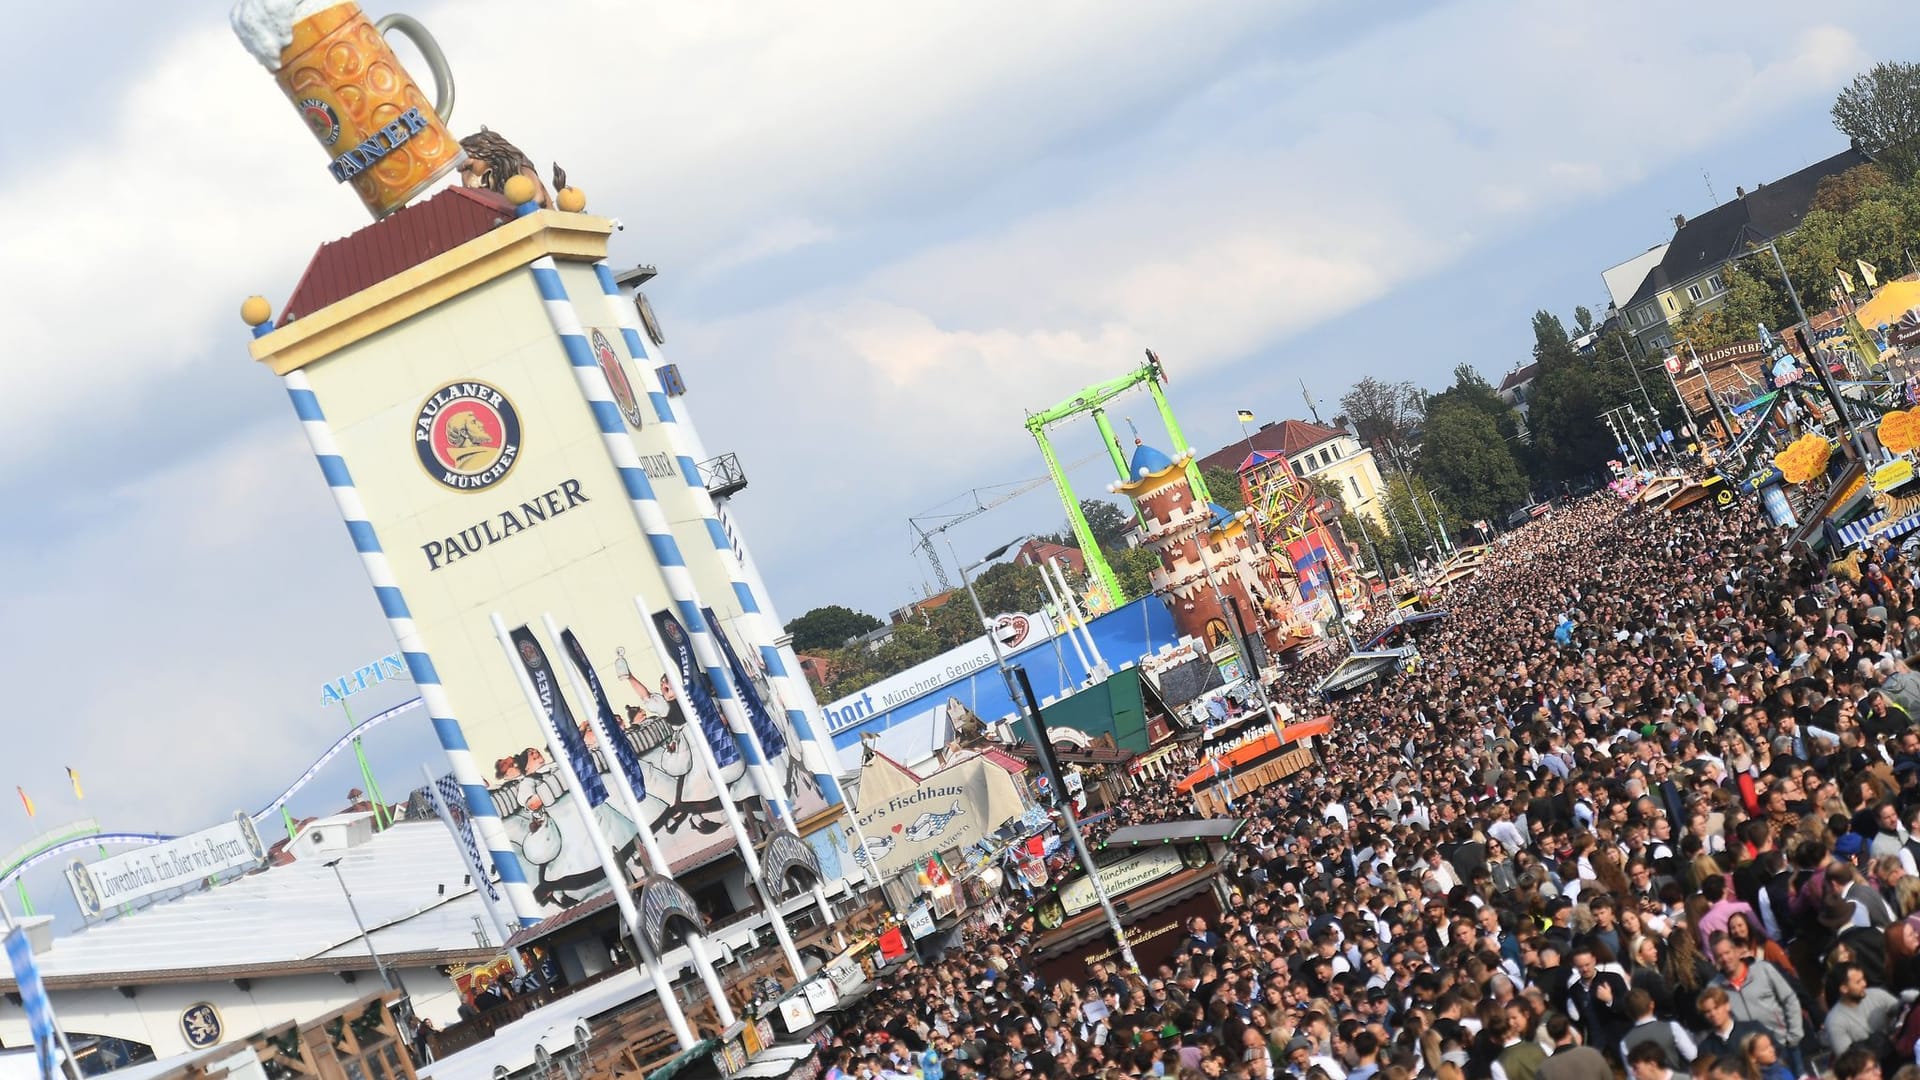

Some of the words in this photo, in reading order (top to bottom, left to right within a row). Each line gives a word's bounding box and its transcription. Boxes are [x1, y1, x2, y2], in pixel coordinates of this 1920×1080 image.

[330, 106, 428, 184] ANER
[1774, 367, 1805, 388] SHOP
[416, 384, 503, 442] PAULANER
[443, 444, 517, 488] MÜNCHEN
[420, 478, 590, 571] PAULANER
[823, 692, 872, 731] hart
[882, 672, 942, 707] Münchner
[945, 651, 990, 680] Genuss
[888, 784, 964, 813] Fischhaus
[150, 855, 175, 880] Ein
[170, 849, 195, 877] Bier
[192, 842, 212, 869] wie
[205, 838, 246, 867] Bayern.
[1085, 867, 1160, 900] Madelbrennerei
[1128, 921, 1179, 948] andelbrennerei
